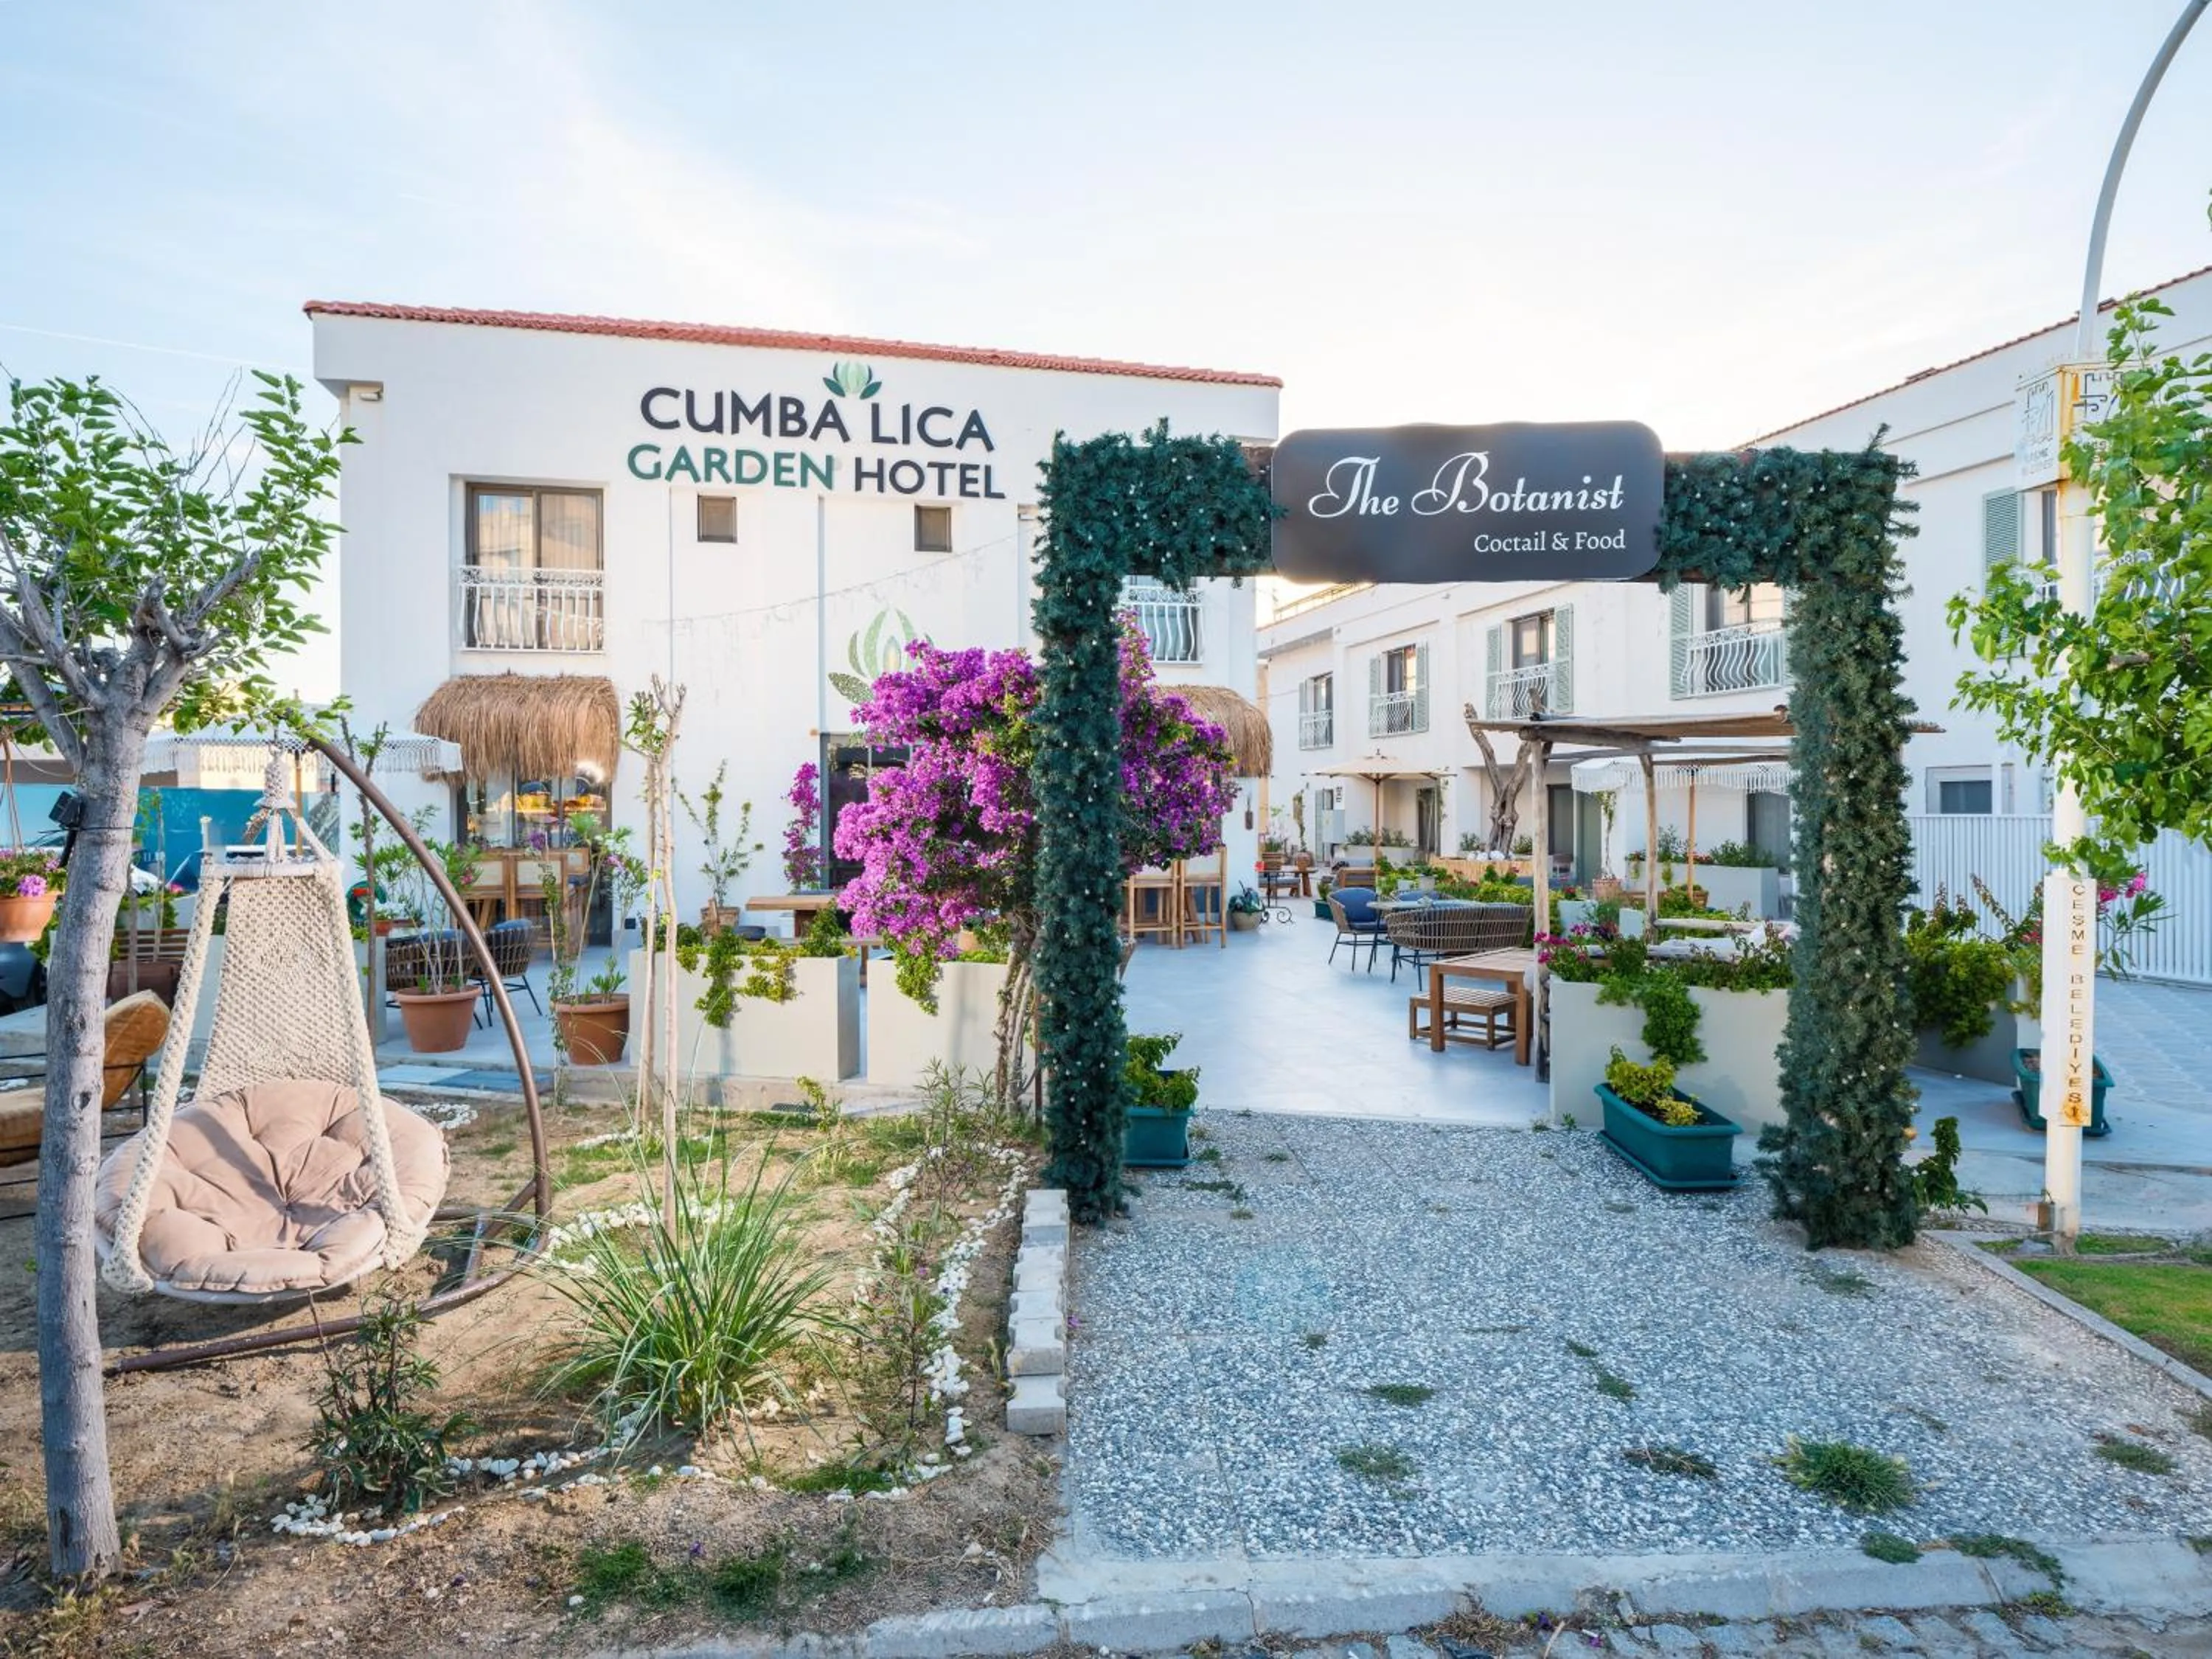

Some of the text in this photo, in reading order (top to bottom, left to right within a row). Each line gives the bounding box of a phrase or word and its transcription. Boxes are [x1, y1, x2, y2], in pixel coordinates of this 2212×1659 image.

[627, 444, 1005, 499] GARDEN HOTEL
[1308, 451, 1624, 518] The Botanist
[1475, 529, 1626, 553] Coctail & Food
